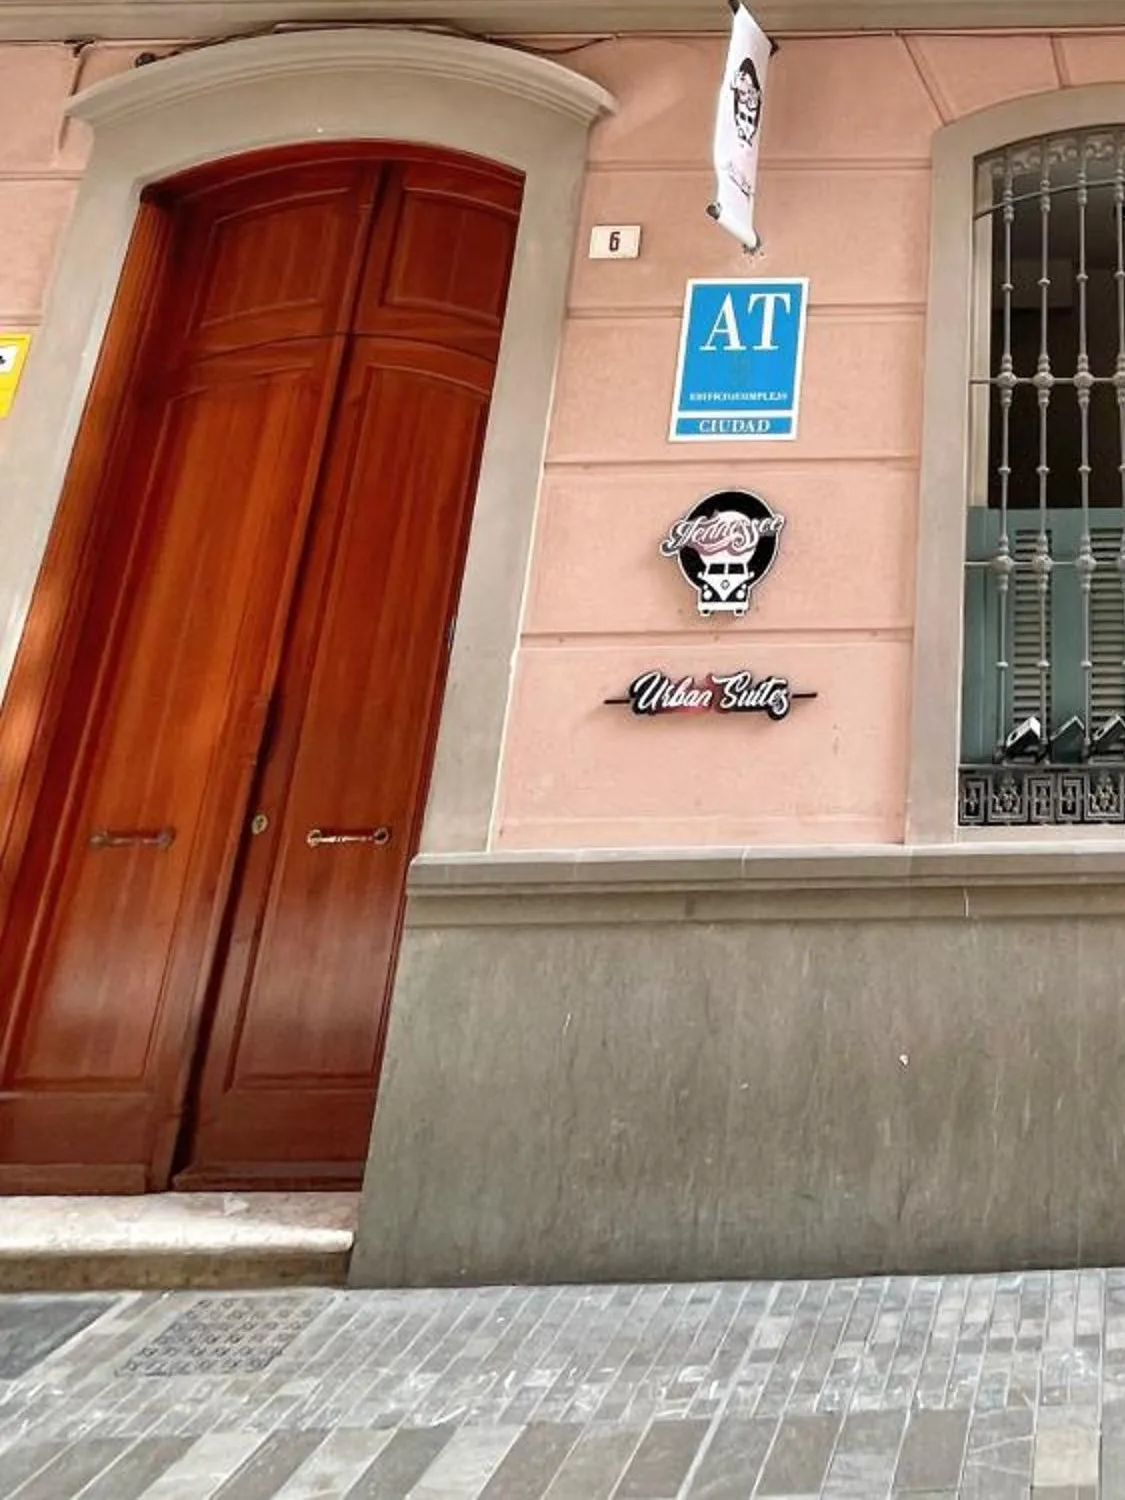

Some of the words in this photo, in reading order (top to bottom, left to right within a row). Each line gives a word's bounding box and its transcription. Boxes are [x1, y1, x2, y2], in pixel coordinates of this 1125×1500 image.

[608, 231, 621, 252] 6
[699, 292, 791, 351] AT
[699, 419, 771, 433] CIUDAD
[632, 671, 712, 710] Urban
[712, 670, 789, 716] Suites
